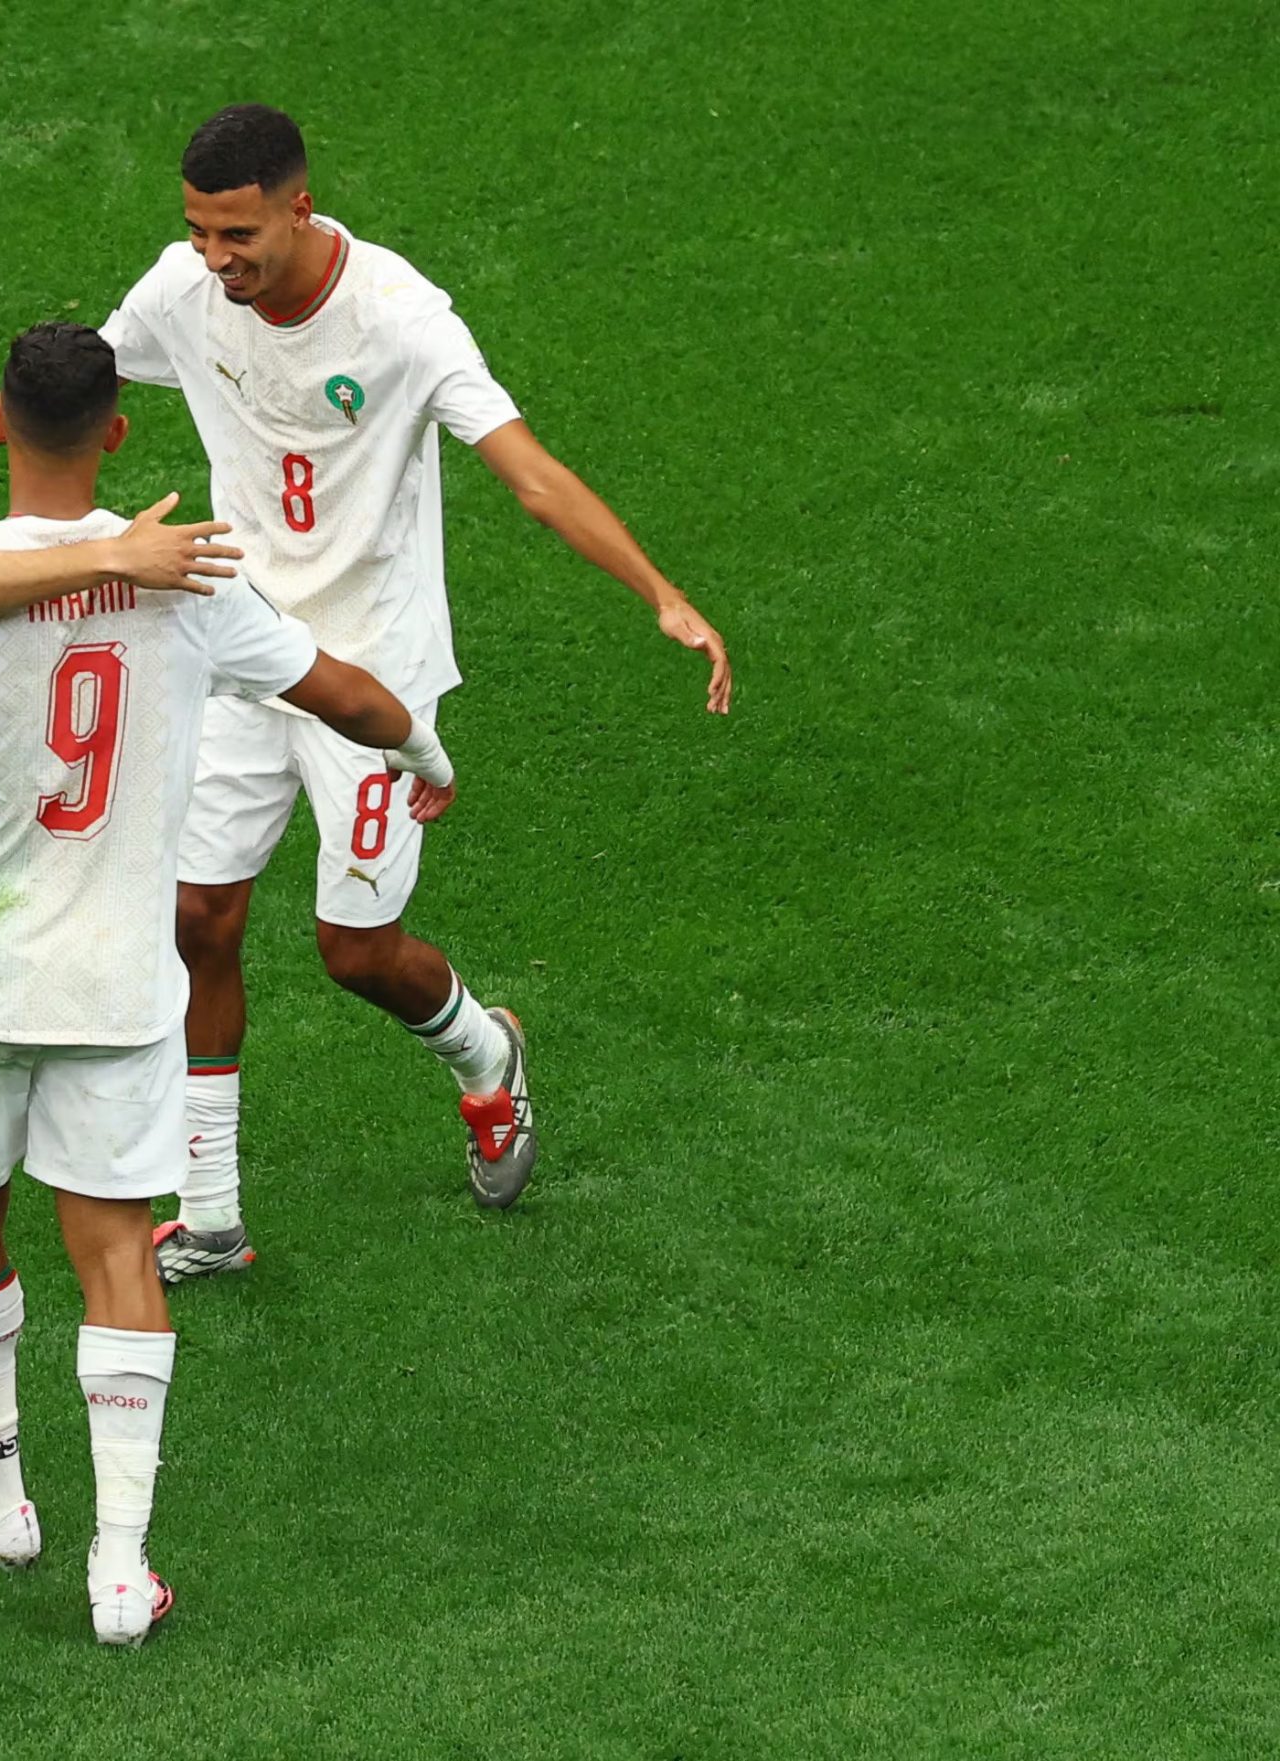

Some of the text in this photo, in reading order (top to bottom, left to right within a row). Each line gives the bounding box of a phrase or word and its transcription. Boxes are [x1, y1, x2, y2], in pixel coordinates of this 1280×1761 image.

[282, 452, 315, 534] 8
[36, 641, 129, 841] 9
[351, 772, 392, 860] 8
